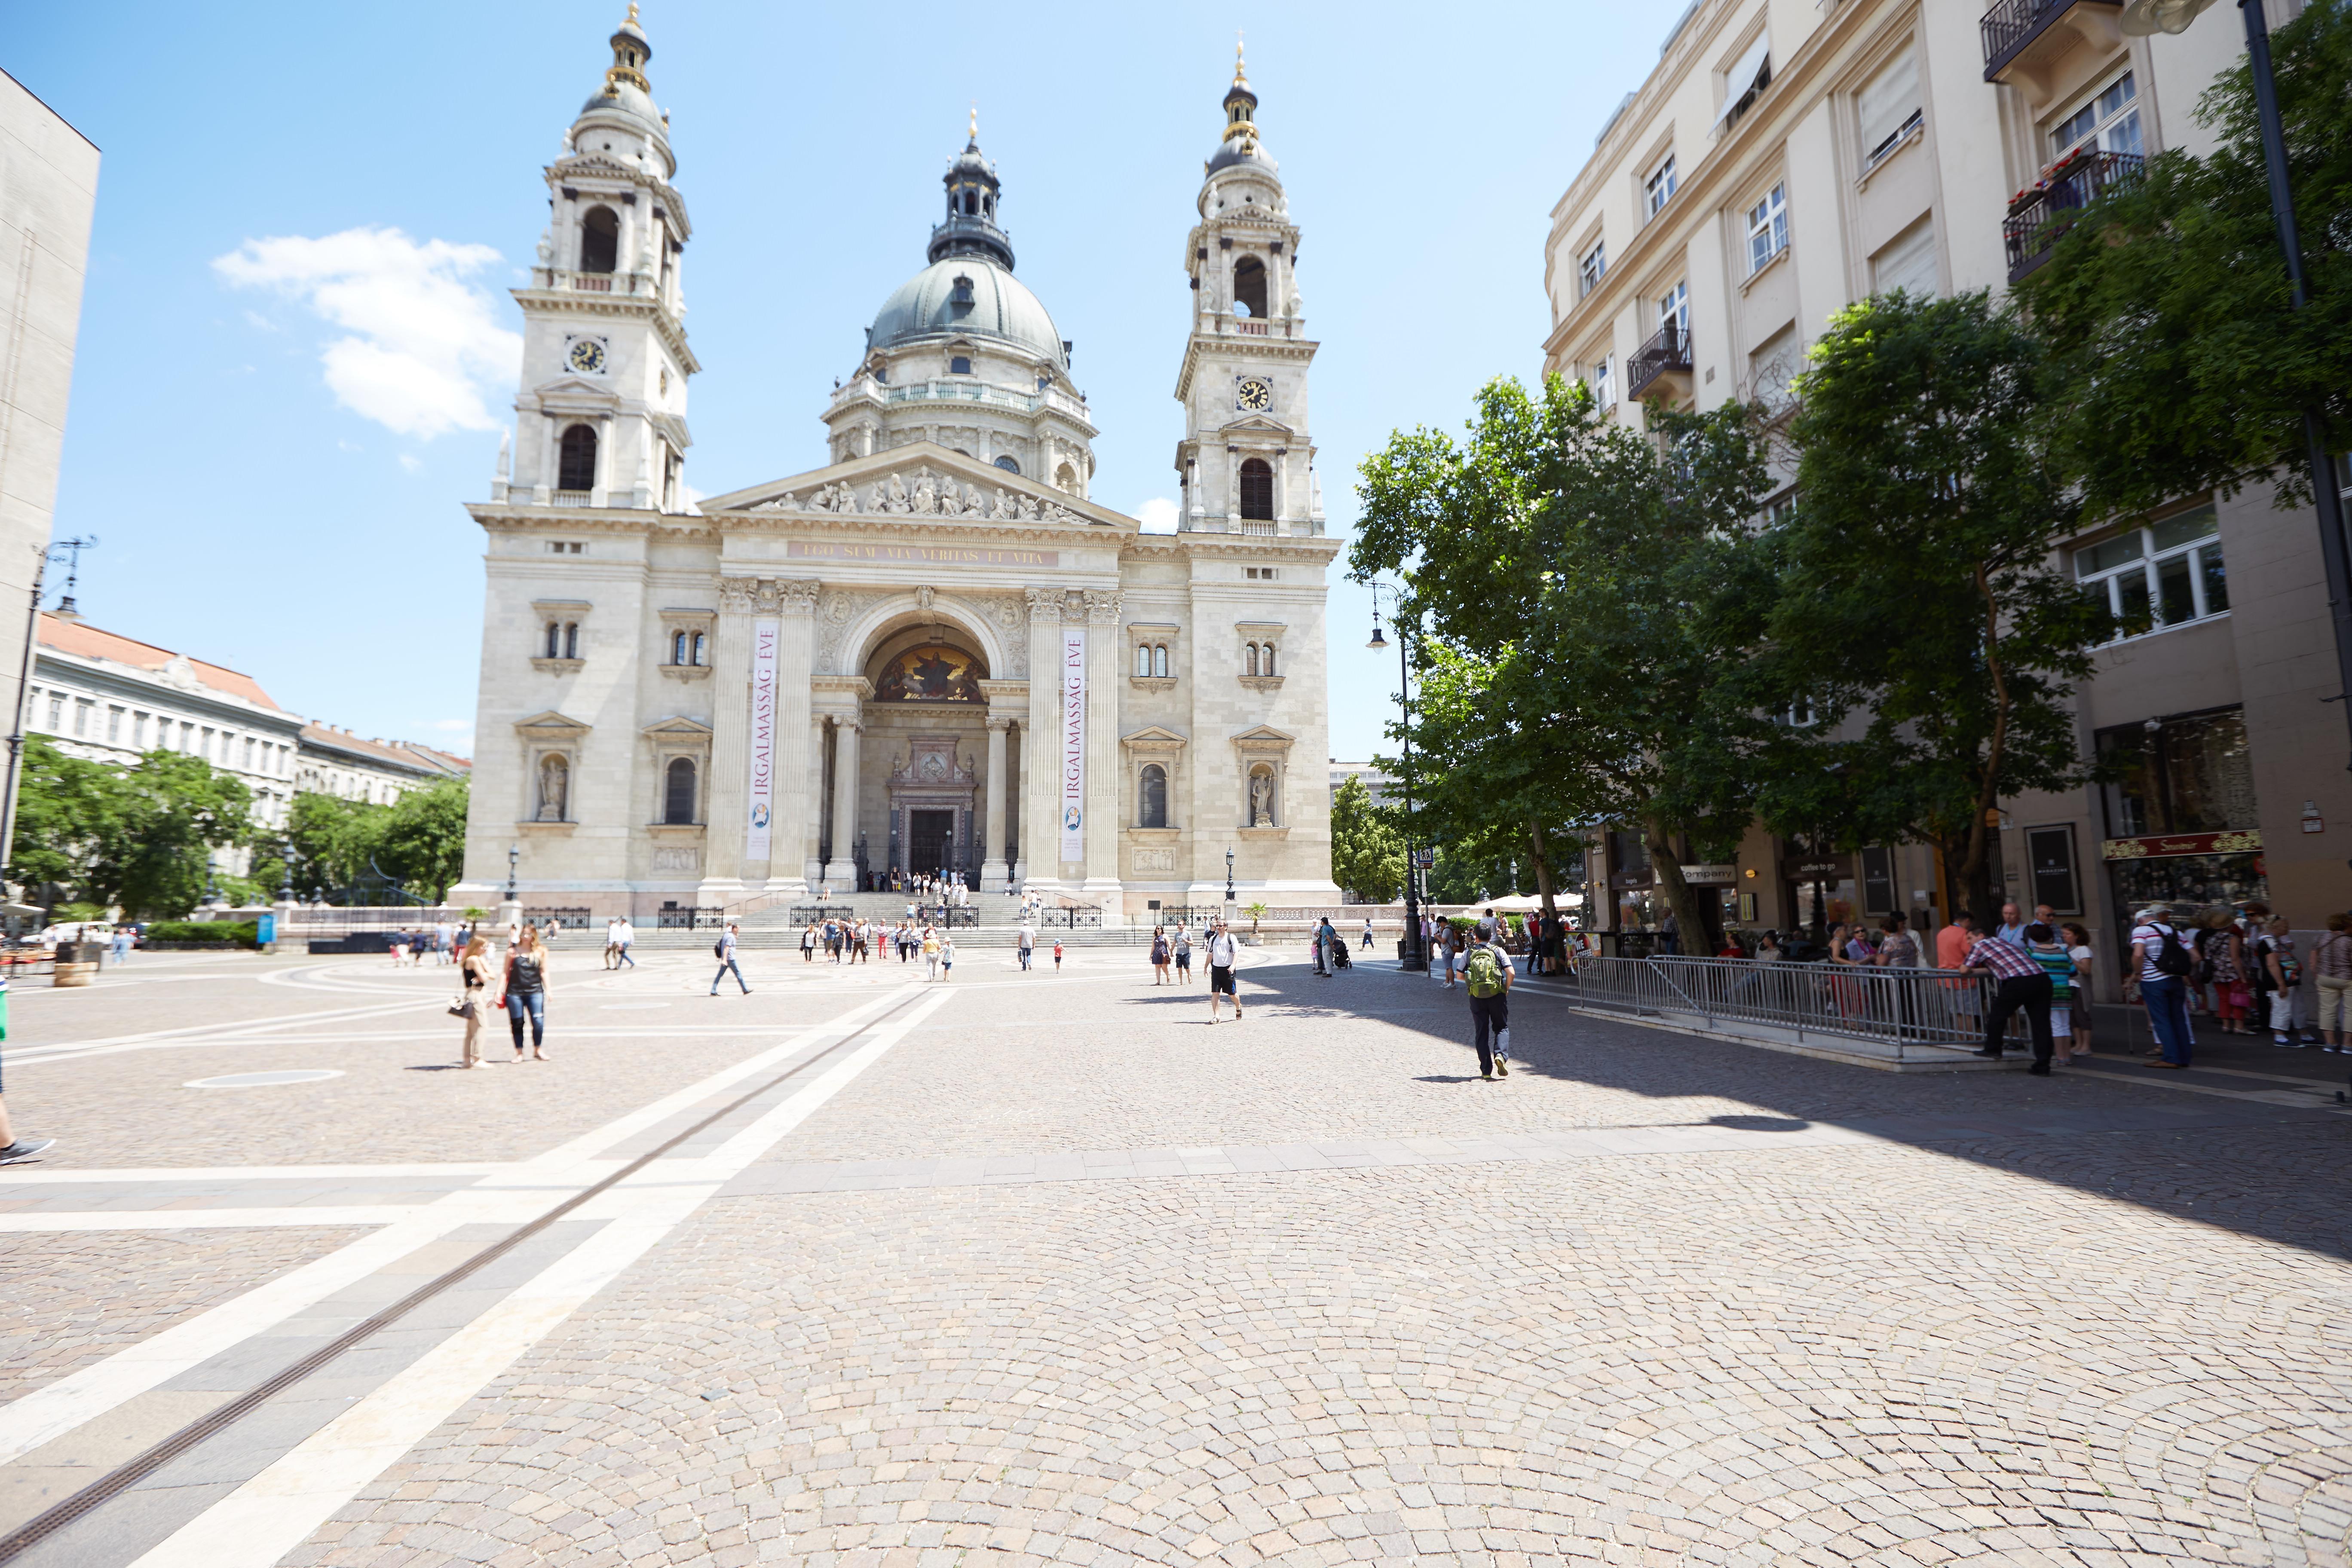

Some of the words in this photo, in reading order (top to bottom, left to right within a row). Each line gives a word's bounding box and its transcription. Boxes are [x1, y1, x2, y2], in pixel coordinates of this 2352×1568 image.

[804, 544, 834, 556] EGO
[844, 545, 875, 557] SUM
[887, 548, 911, 559] VIA
[921, 549, 979, 561] VERITAS
[988, 551, 1004, 562] ET
[1014, 553, 1043, 564] VITA
[756, 630, 773, 659] ÉVE
[1065, 639, 1081, 668] ÉVE
[753, 669, 771, 795] IRGALMASSÁG
[1065, 677, 1081, 799] IRGALMASSÁG
[1576, 939, 1584, 950] WE
